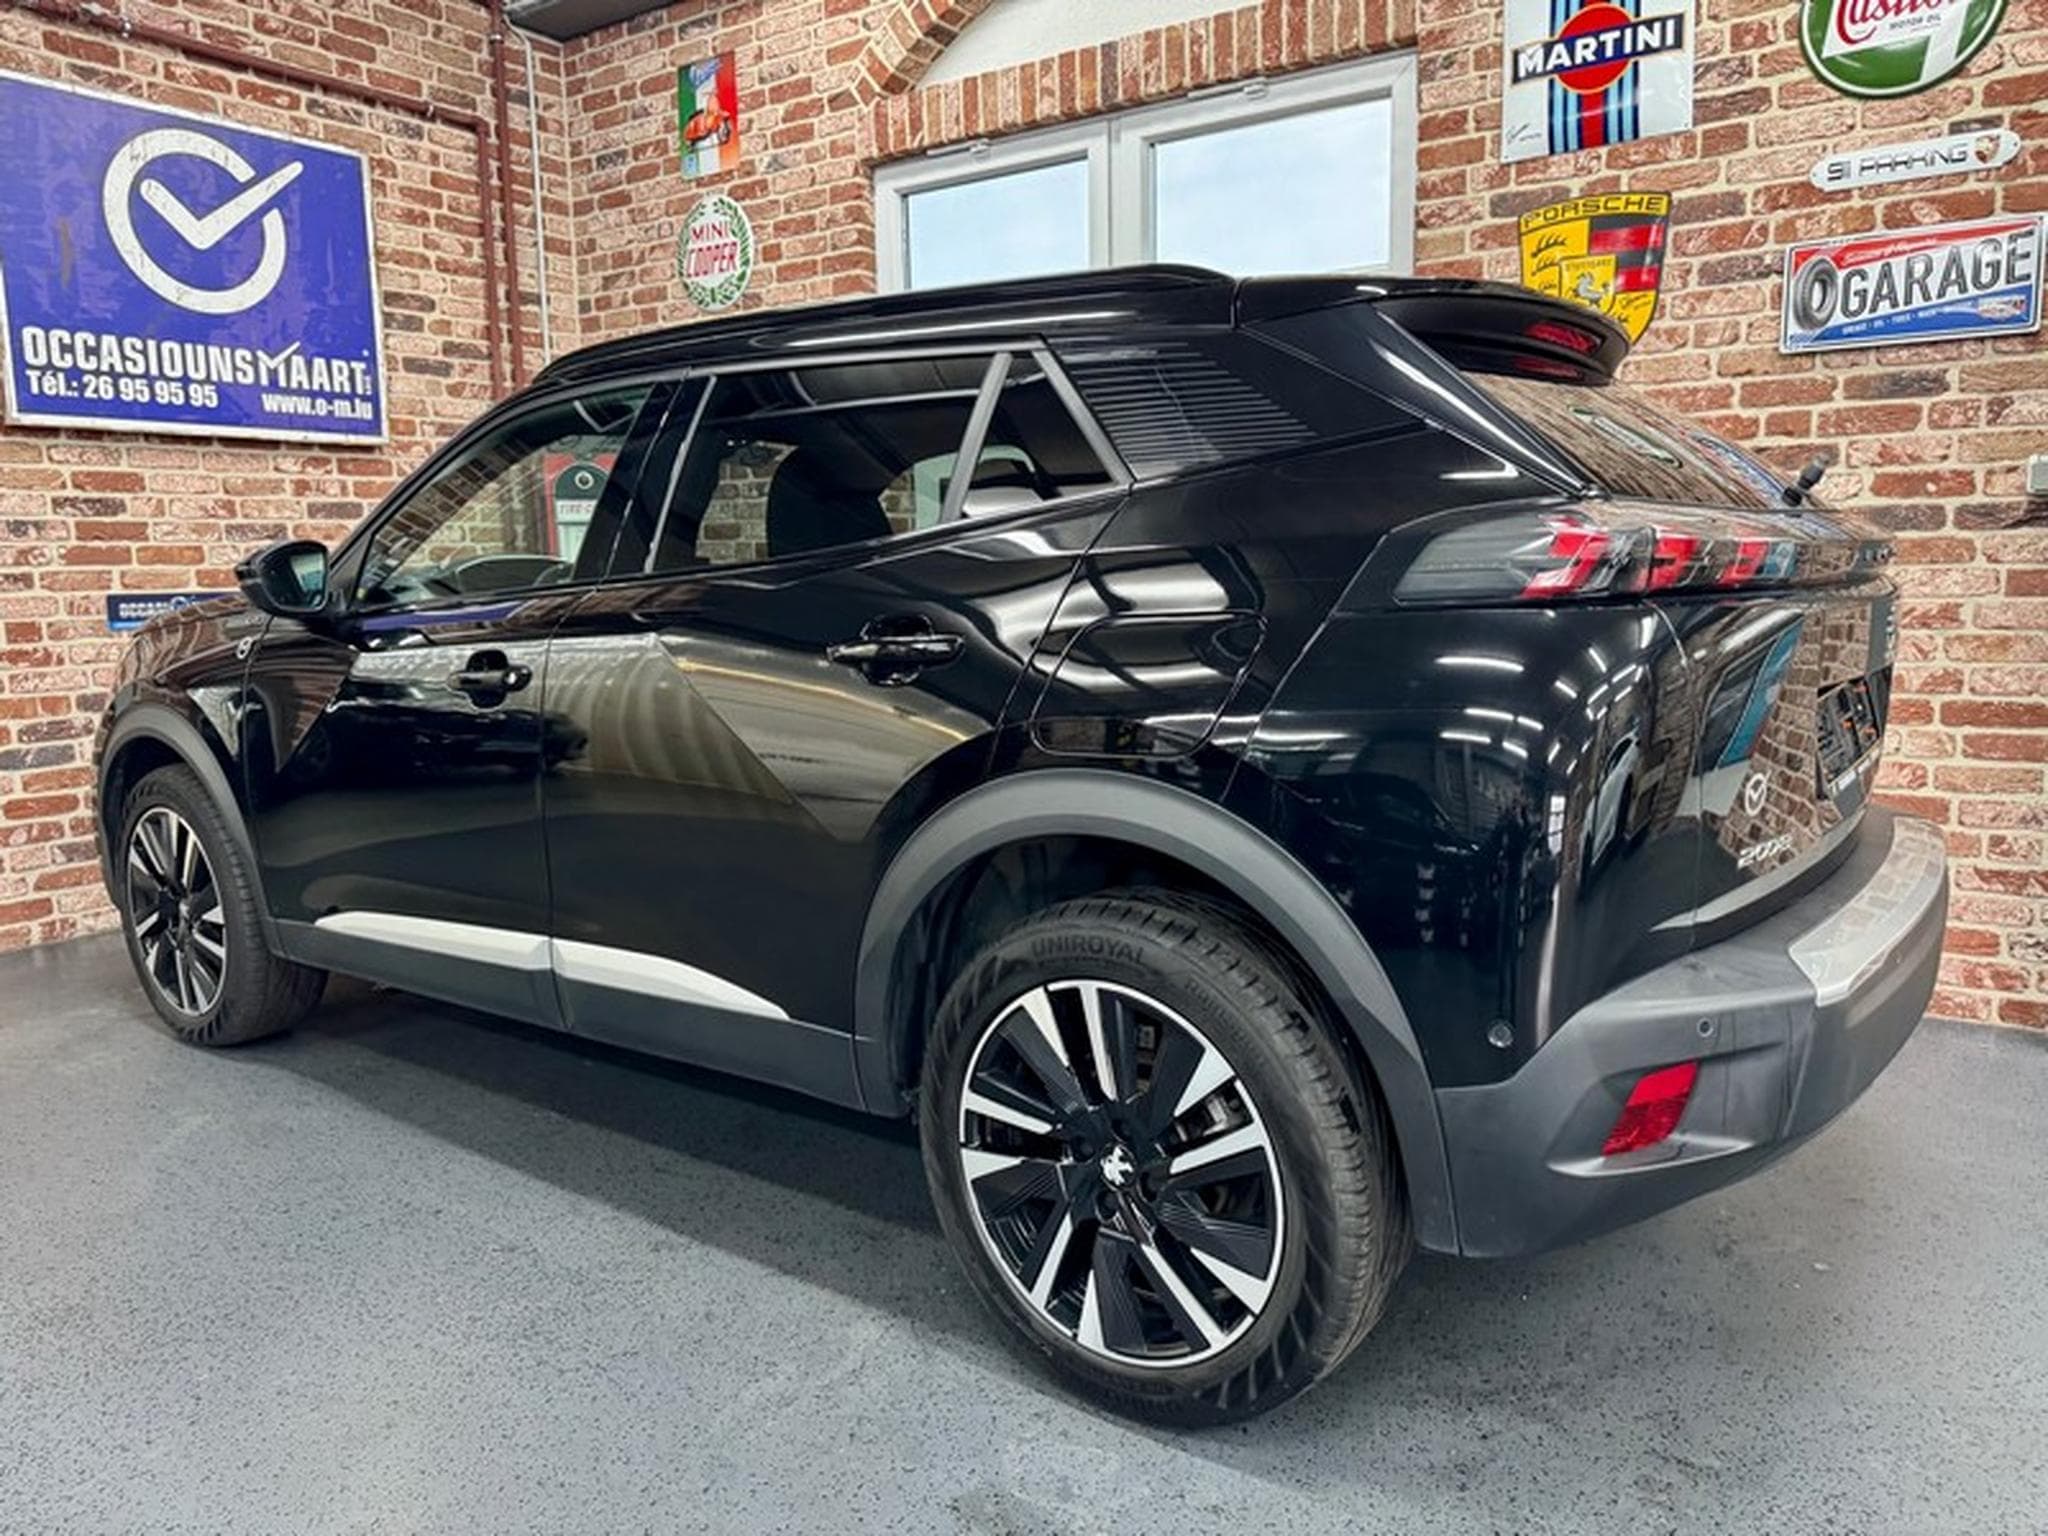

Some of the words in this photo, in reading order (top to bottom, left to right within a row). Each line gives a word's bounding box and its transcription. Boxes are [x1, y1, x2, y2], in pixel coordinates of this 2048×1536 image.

[1517, 19, 1675, 78] MARTINI
[1858, 143, 1968, 177] PARKING
[1524, 195, 1665, 228] PORSCHE
[691, 220, 729, 244] MINI
[687, 241, 738, 278] COOPER
[1840, 230, 2035, 319] GARAGE
[82, 374, 114, 400] 26
[119, 377, 150, 403] 95
[154, 381, 185, 406] 95
[189, 384, 219, 408] 95
[261, 393, 373, 420] www.o-m.lu
[1031, 936, 1144, 963] UNIROYAL
